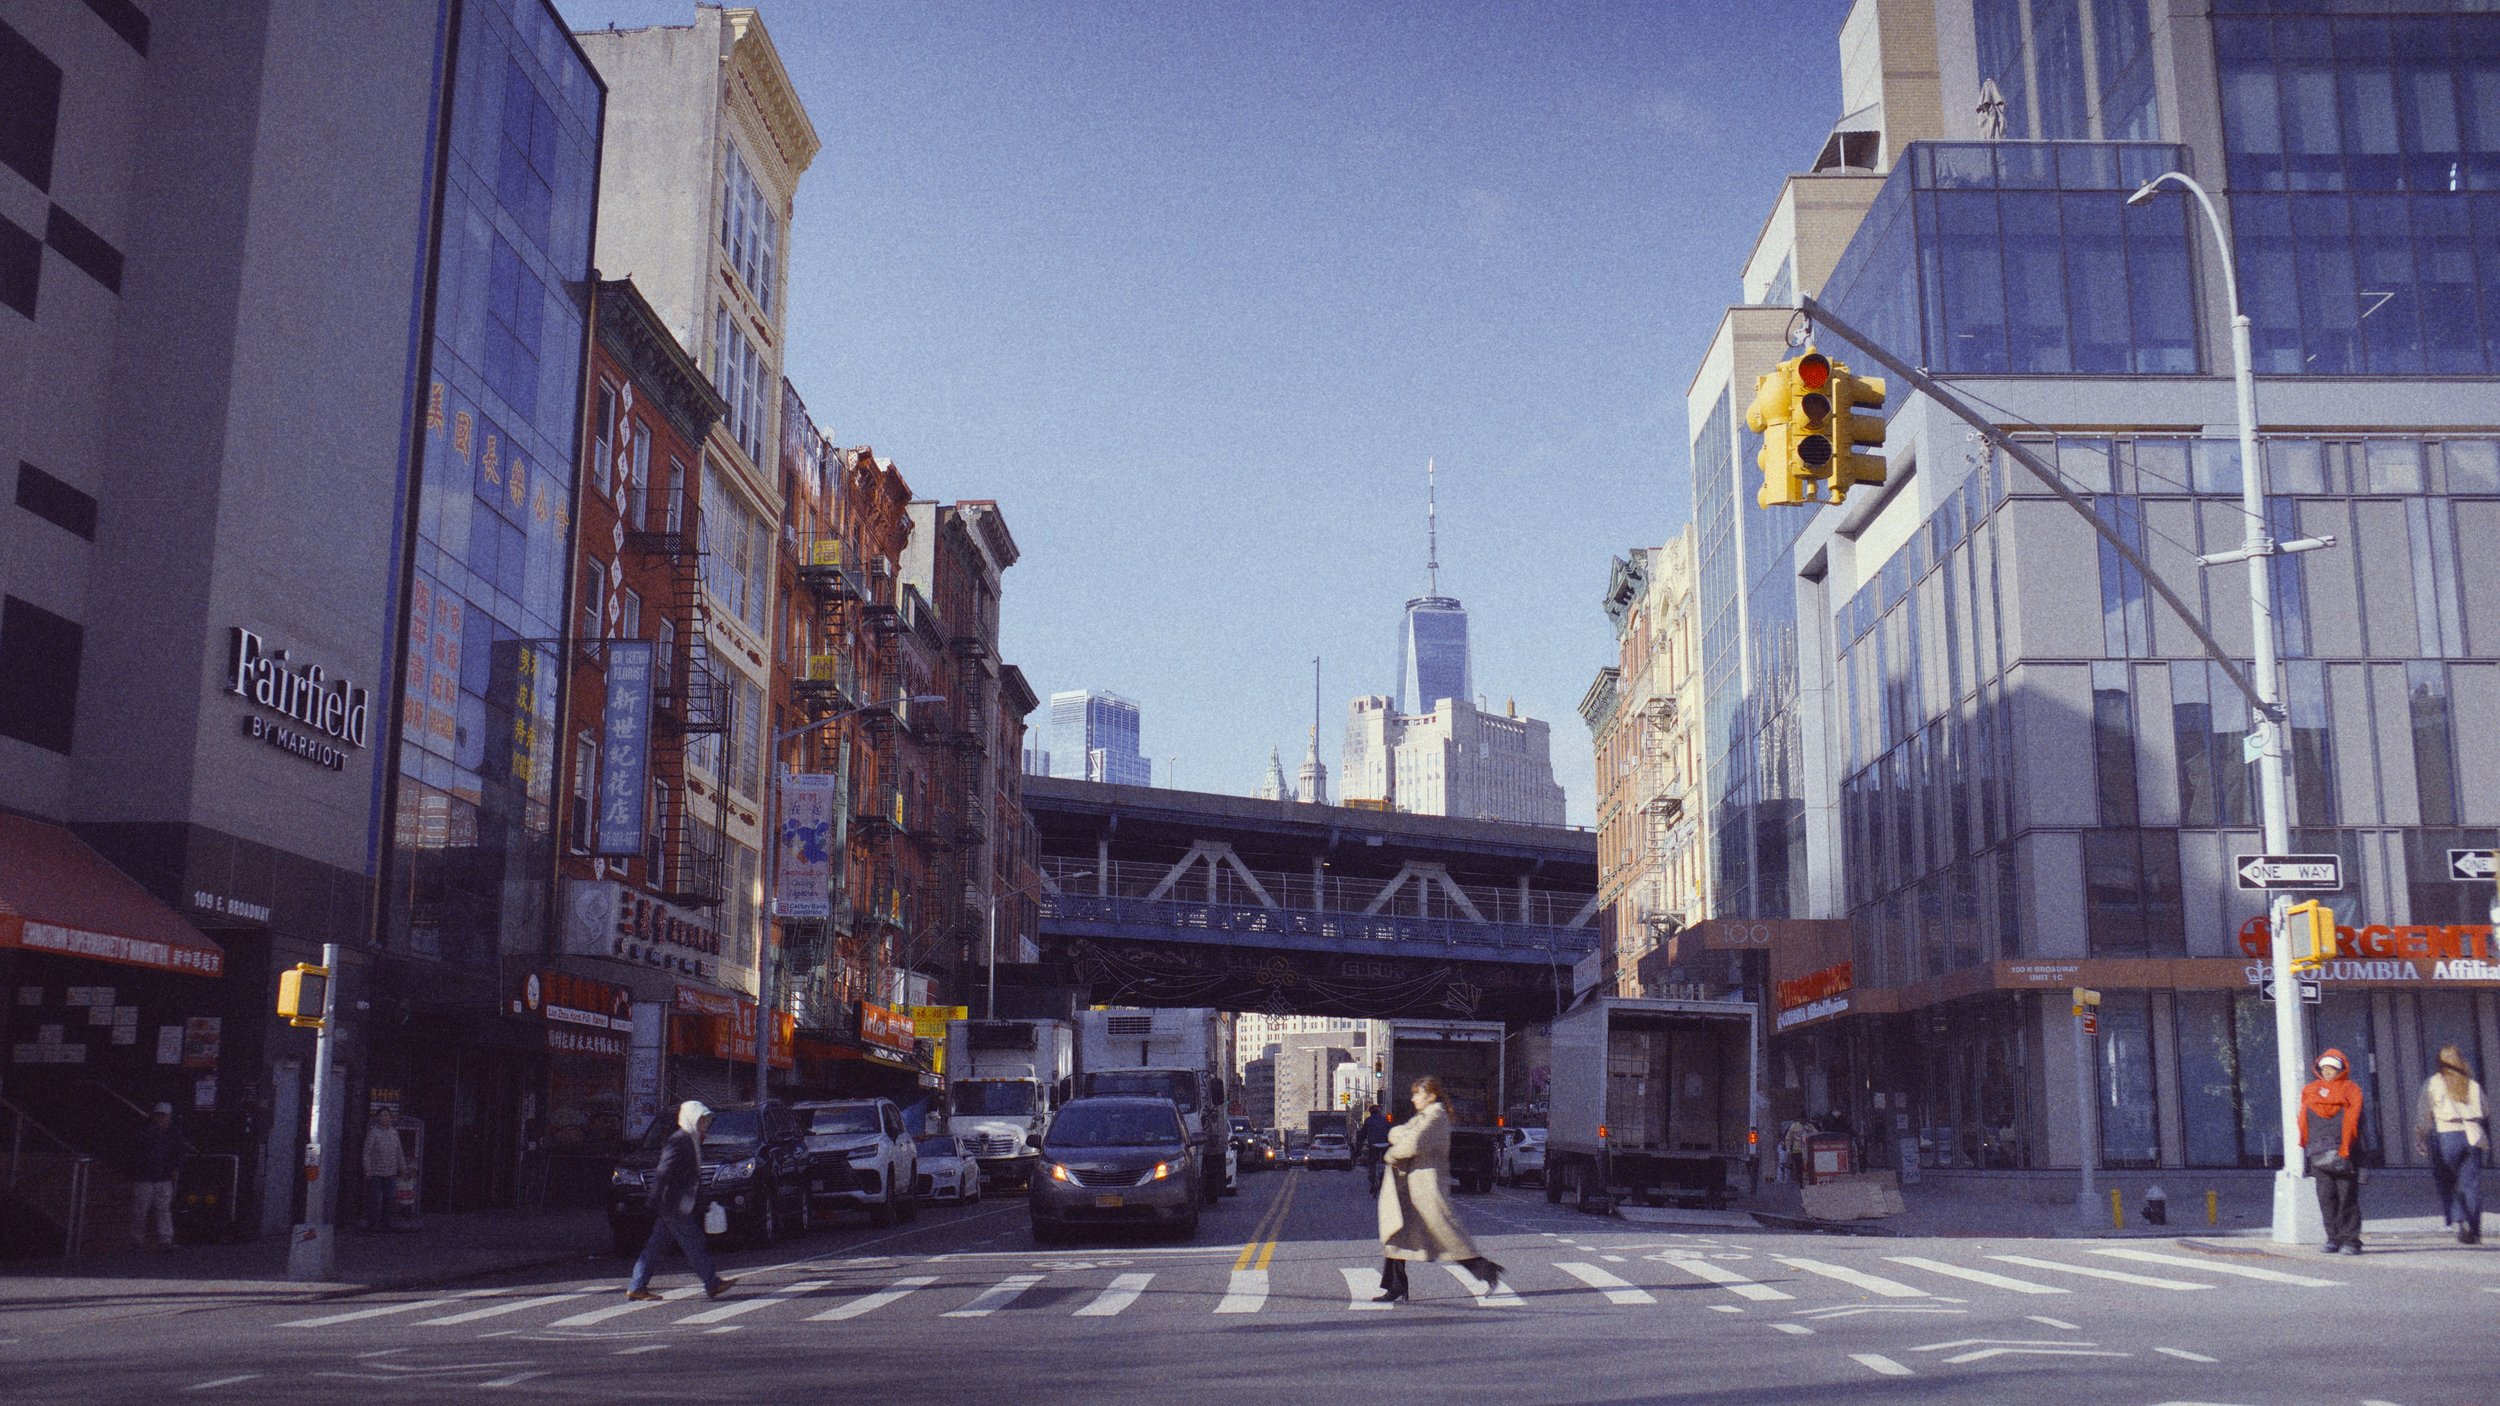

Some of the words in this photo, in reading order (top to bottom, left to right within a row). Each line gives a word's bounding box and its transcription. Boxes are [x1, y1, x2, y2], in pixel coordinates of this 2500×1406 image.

[816, 542, 836, 562] 福
[613, 667, 645, 681] FLORIST
[233, 627, 369, 749] Fairfield
[252, 716, 272, 740] BY
[276, 726, 348, 772] MARRIOTT
[606, 686, 641, 825] 新世紀花店
[2251, 866, 2281, 879] ONE
[2298, 865, 2330, 879] WAY
[2464, 859, 2489, 871] ONE
[194, 890, 214, 909] 109
[216, 896, 225, 912] E.
[228, 899, 271, 922] BROADWAY
[1720, 924, 1769, 944] 100
[2336, 924, 2494, 959] RGENT
[2301, 962, 2421, 980] OLUMBIA
